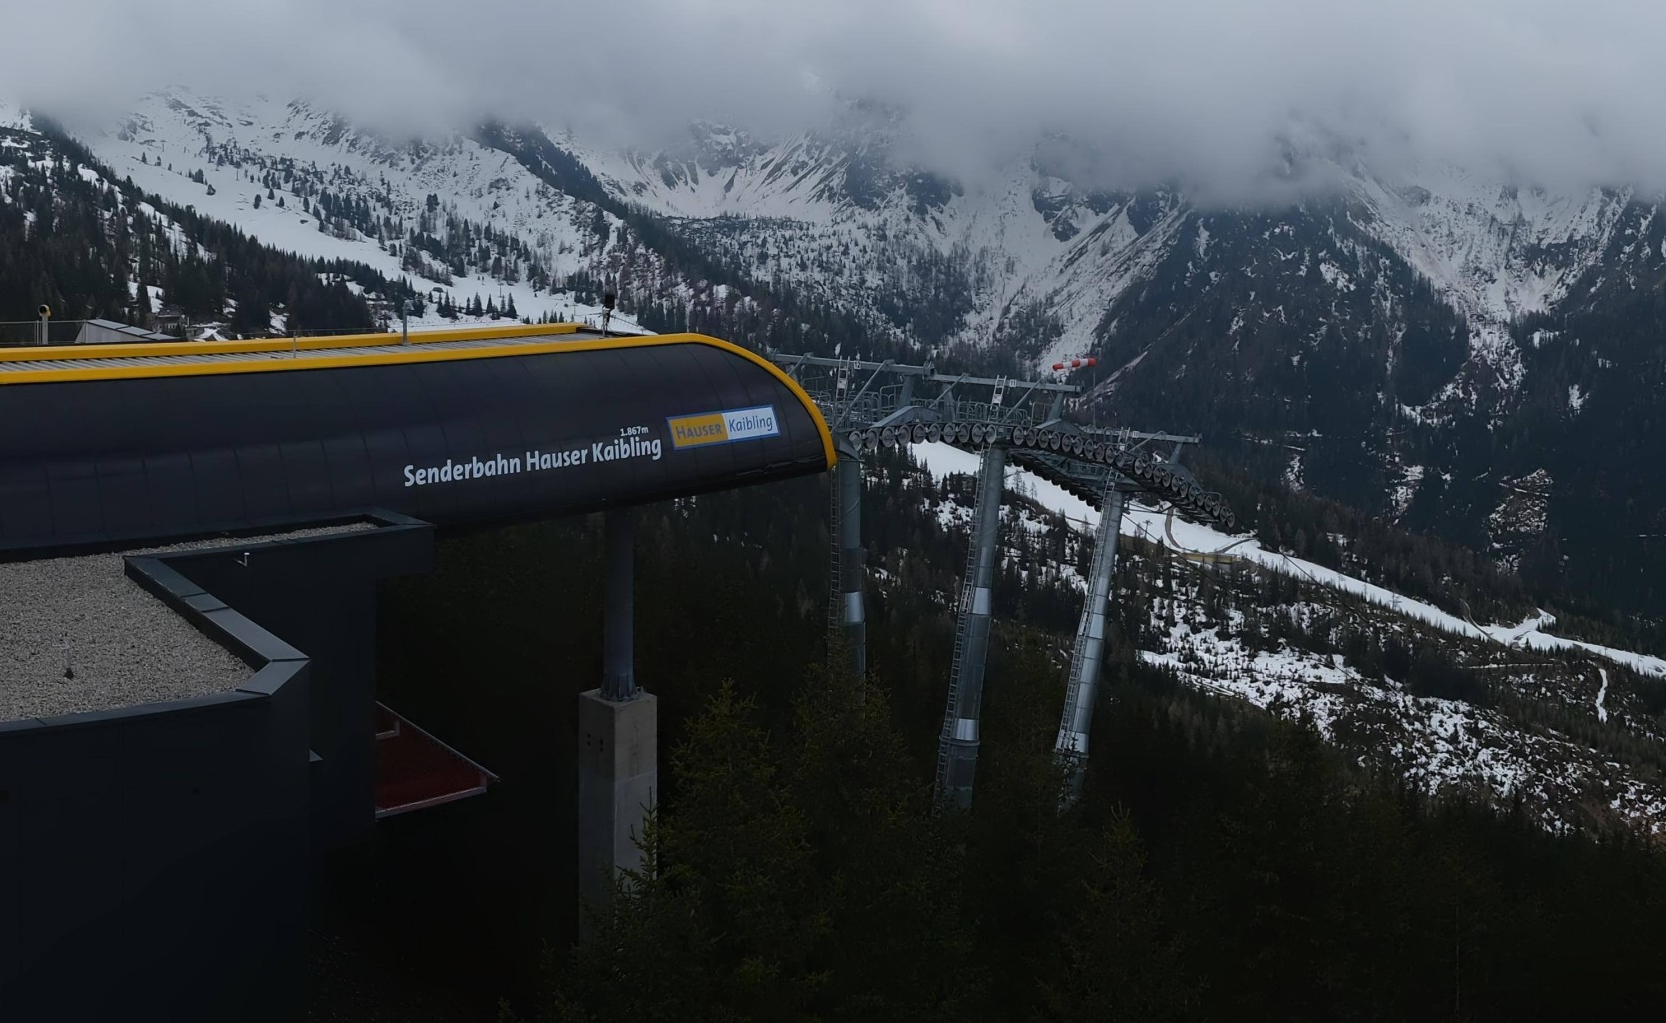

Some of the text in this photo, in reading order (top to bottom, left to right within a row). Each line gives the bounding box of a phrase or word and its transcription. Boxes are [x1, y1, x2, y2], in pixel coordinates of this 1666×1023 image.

[619, 426, 649, 437] 1.867m
[675, 415, 773, 439] HAUSER Kaibling
[404, 436, 662, 487] Senderbahn Hauser Kaibling
